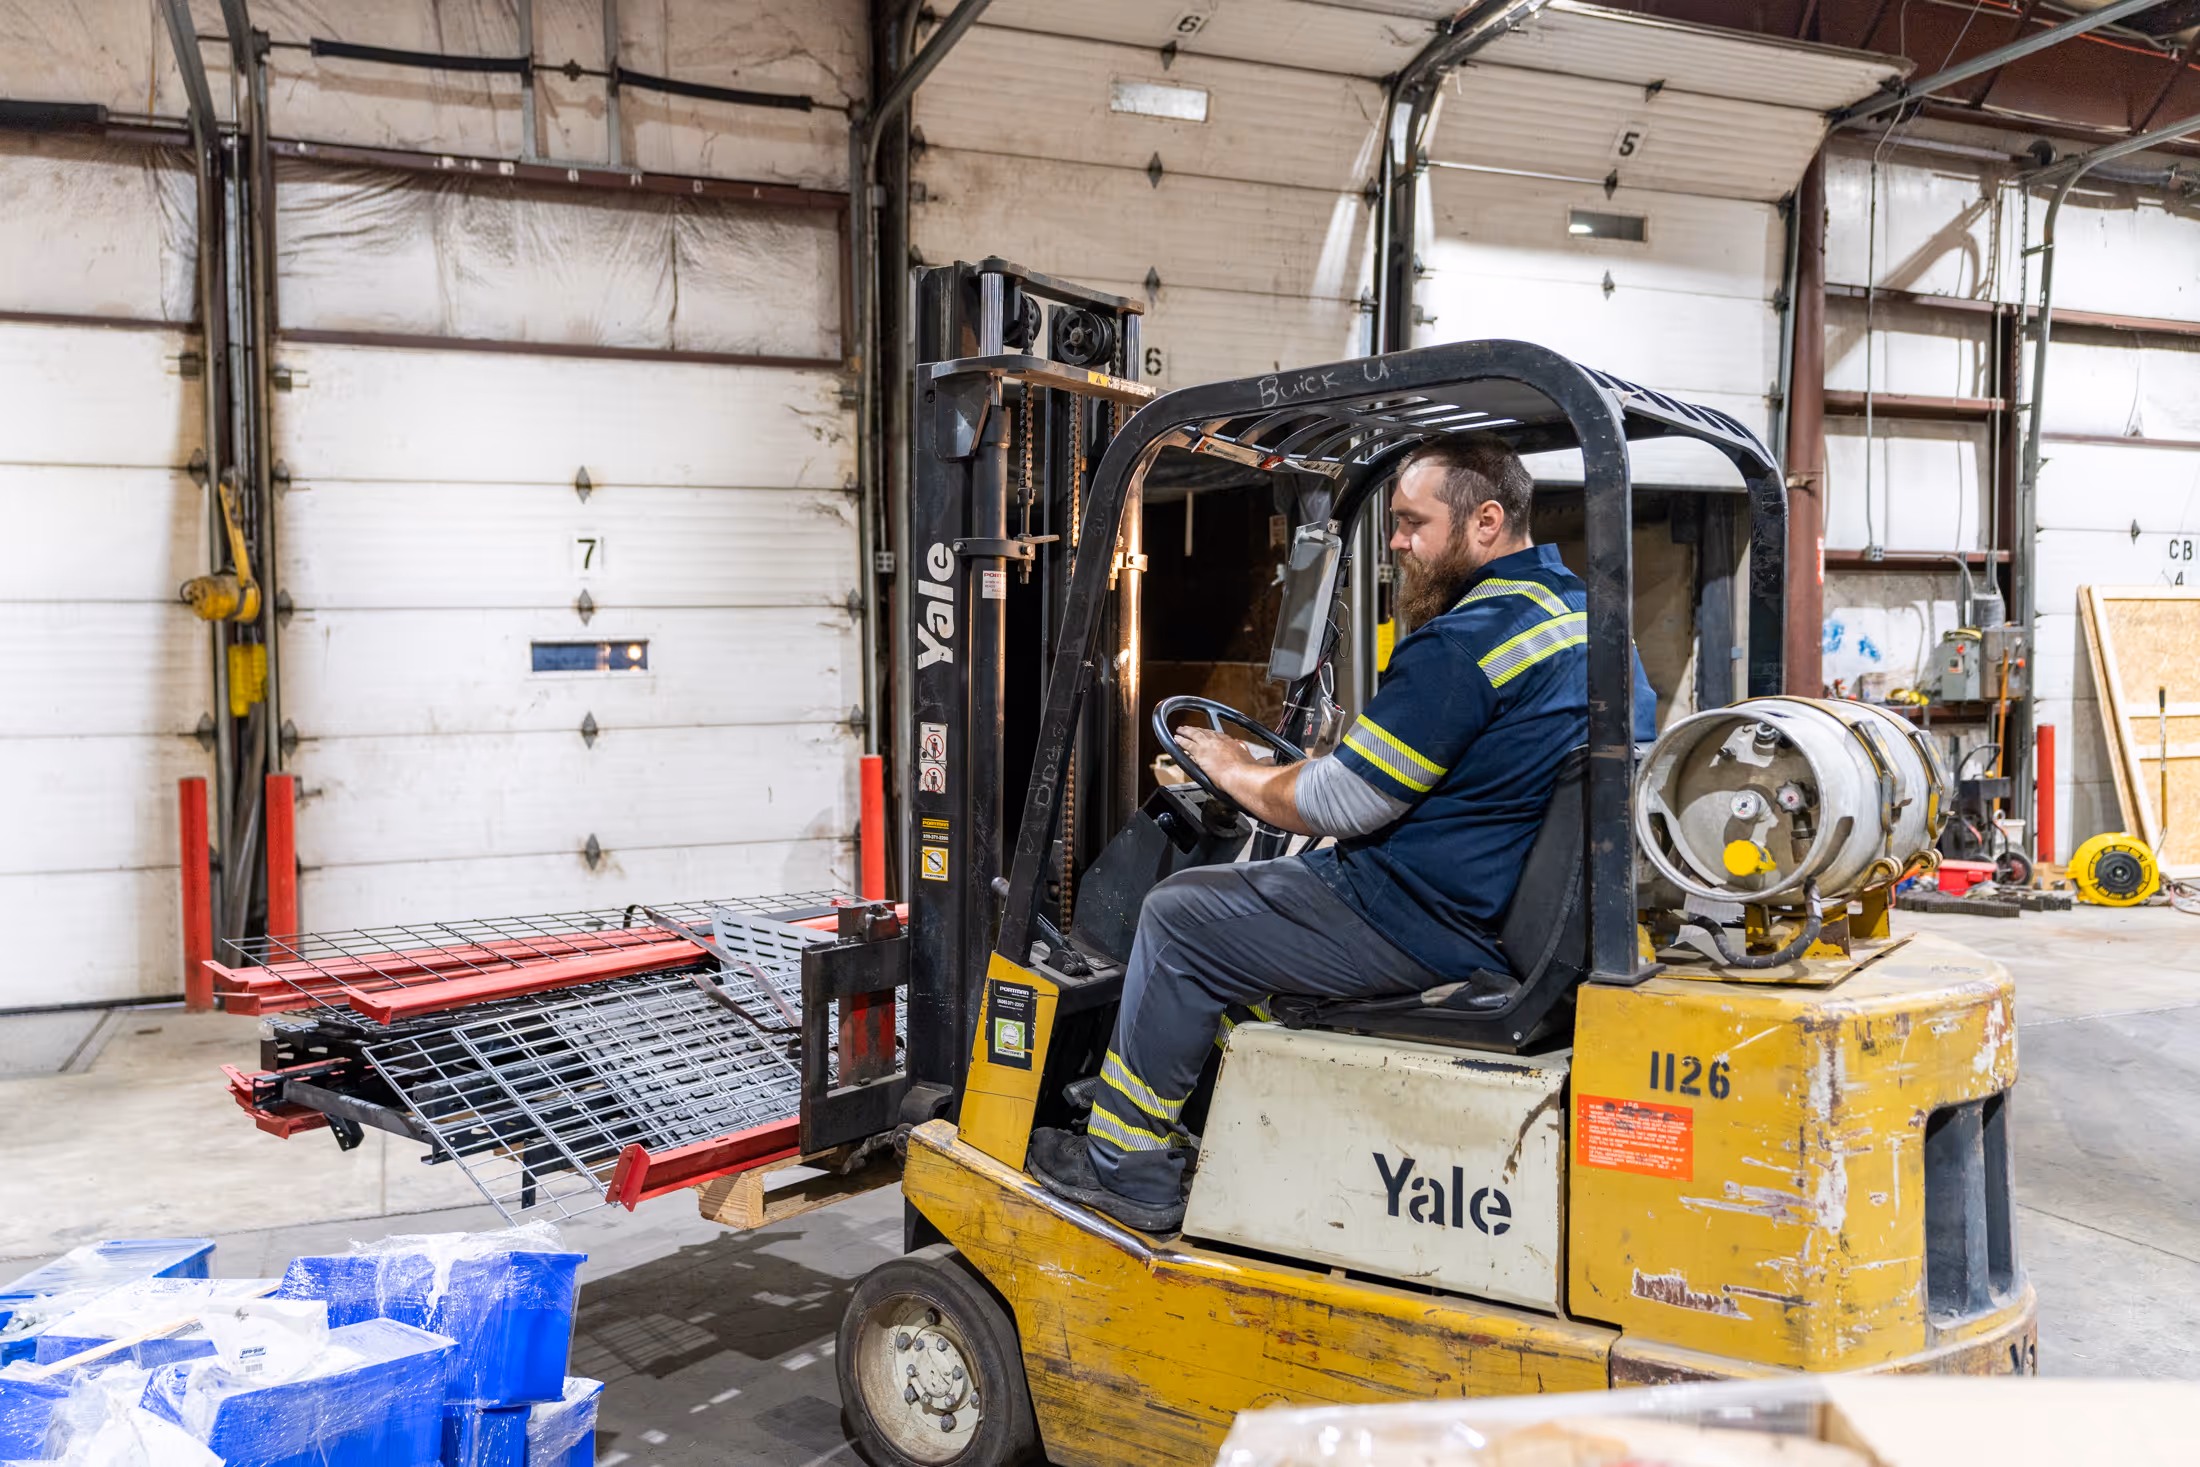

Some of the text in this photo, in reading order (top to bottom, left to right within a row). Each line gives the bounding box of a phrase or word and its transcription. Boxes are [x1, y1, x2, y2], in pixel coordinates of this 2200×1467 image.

[1177, 15, 1201, 32] 6
[1618, 131, 1640, 157] 5
[1145, 347, 1162, 376] 6
[577, 538, 596, 570] 7
[2174, 571, 2185, 586] 4
[917, 542, 955, 670] Yale
[1650, 1051, 1730, 1100] 1126
[1372, 1152, 1512, 1236] Yale
